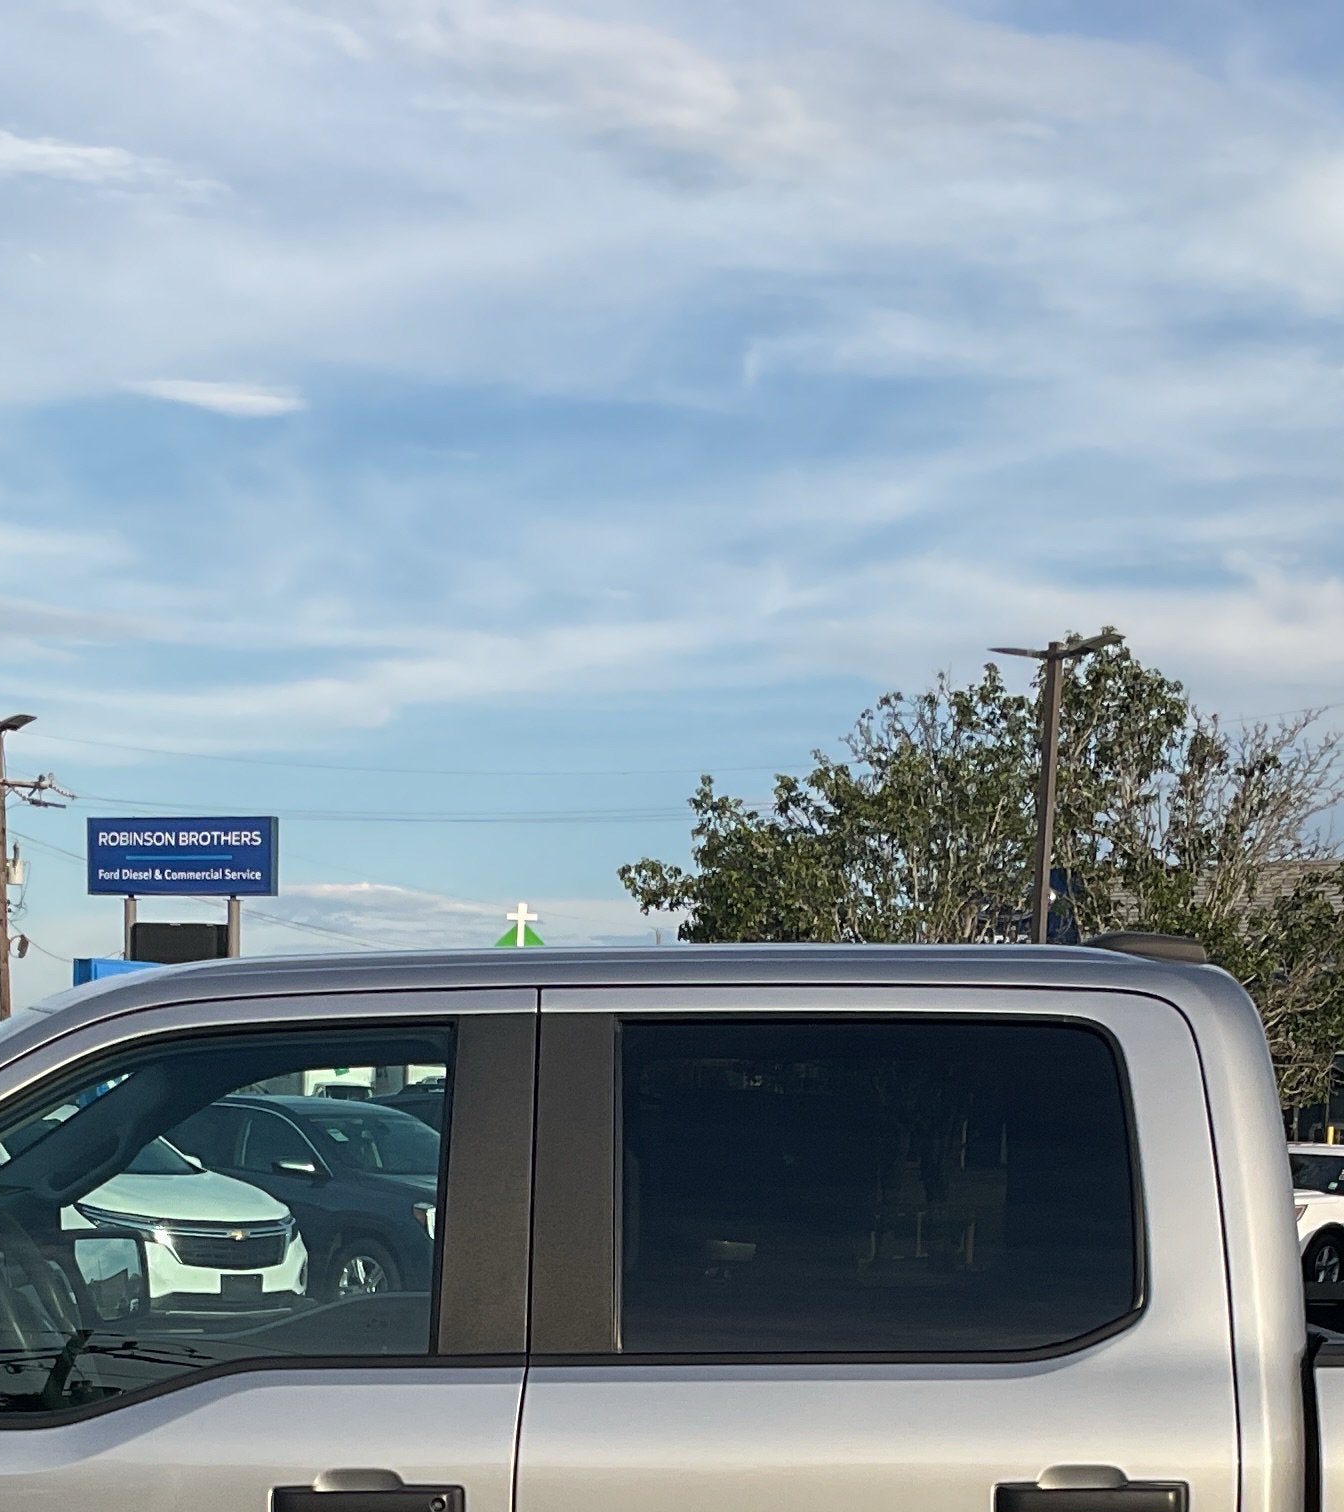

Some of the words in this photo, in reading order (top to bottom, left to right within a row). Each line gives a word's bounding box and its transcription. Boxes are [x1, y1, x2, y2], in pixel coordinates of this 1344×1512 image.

[98, 831, 175, 847] ROBINSON
[179, 831, 262, 846] BROTHERS
[98, 868, 120, 880] Ford
[122, 868, 152, 880] Diesel
[154, 869, 163, 880] &
[164, 868, 222, 880] Commercial
[224, 869, 262, 880] Service
